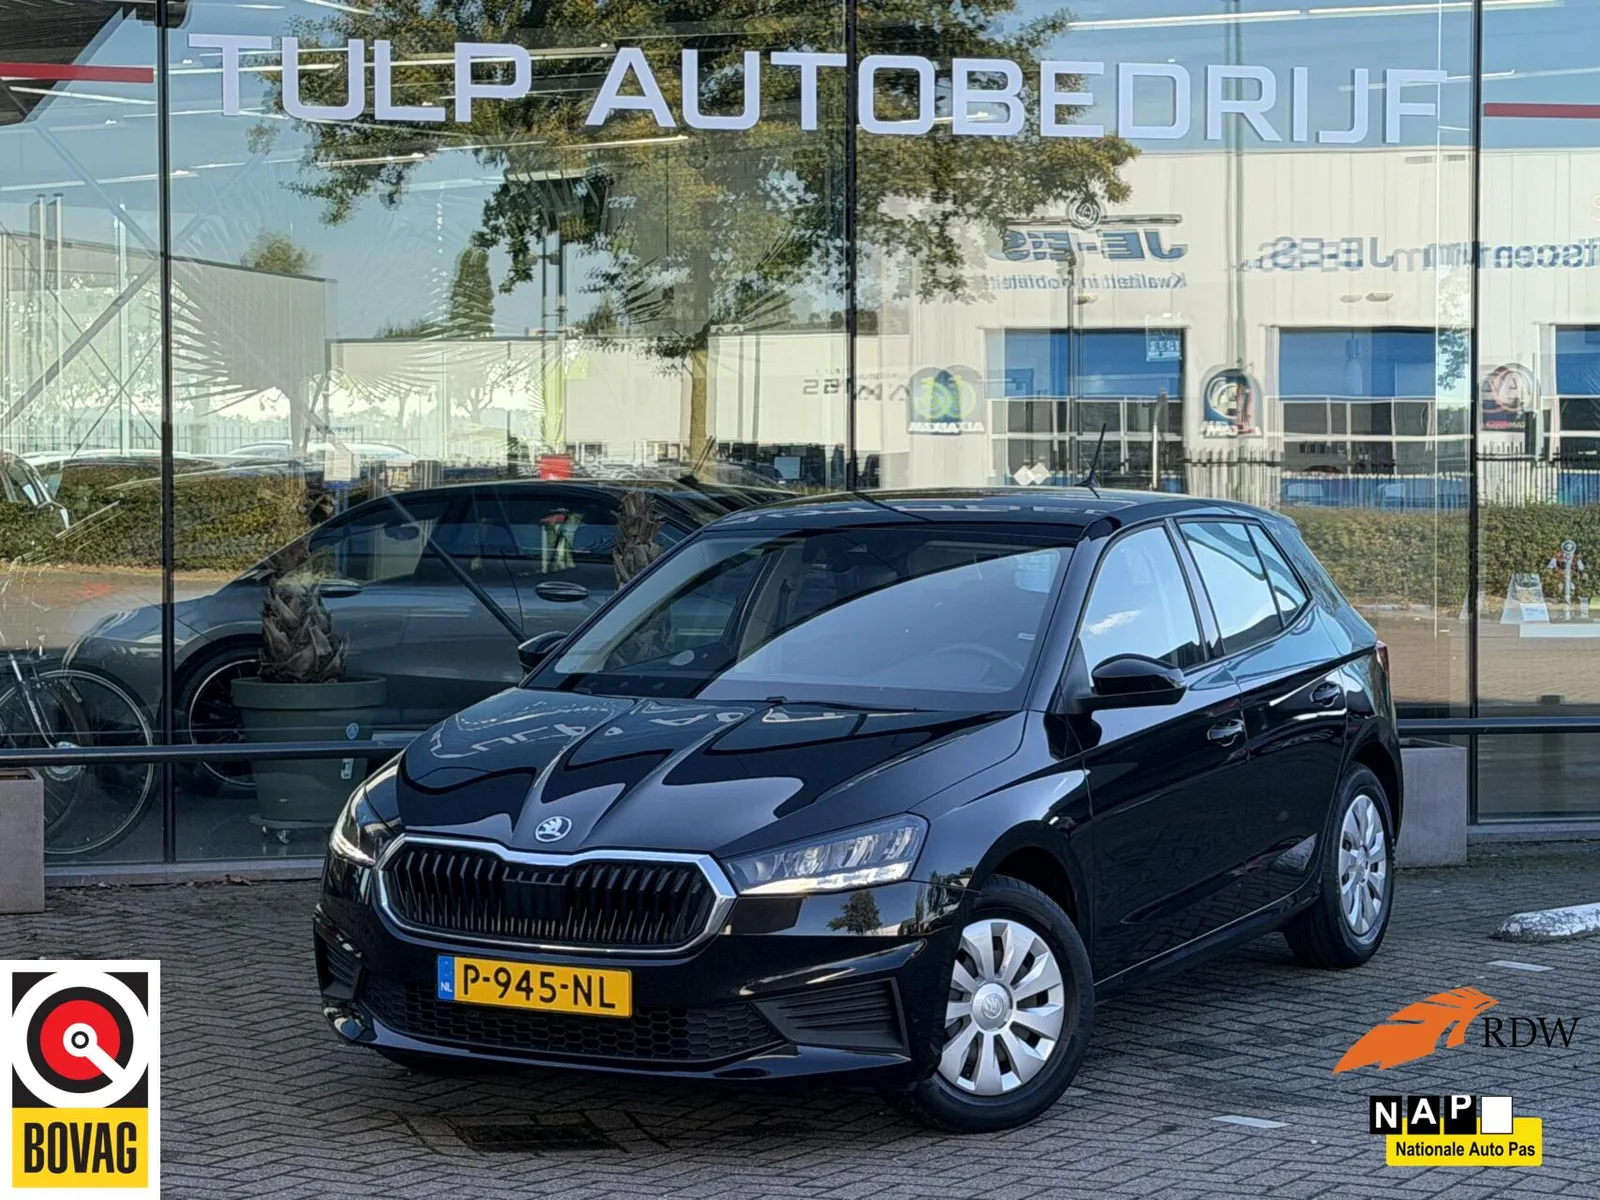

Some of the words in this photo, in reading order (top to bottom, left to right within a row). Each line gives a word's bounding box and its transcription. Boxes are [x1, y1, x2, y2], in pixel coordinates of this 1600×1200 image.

[188, 33, 532, 123] TULP
[585, 46, 1449, 145] AUTOBEDRIJF
[440, 981, 453, 993] NL
[463, 964, 616, 1010] P-945-NL
